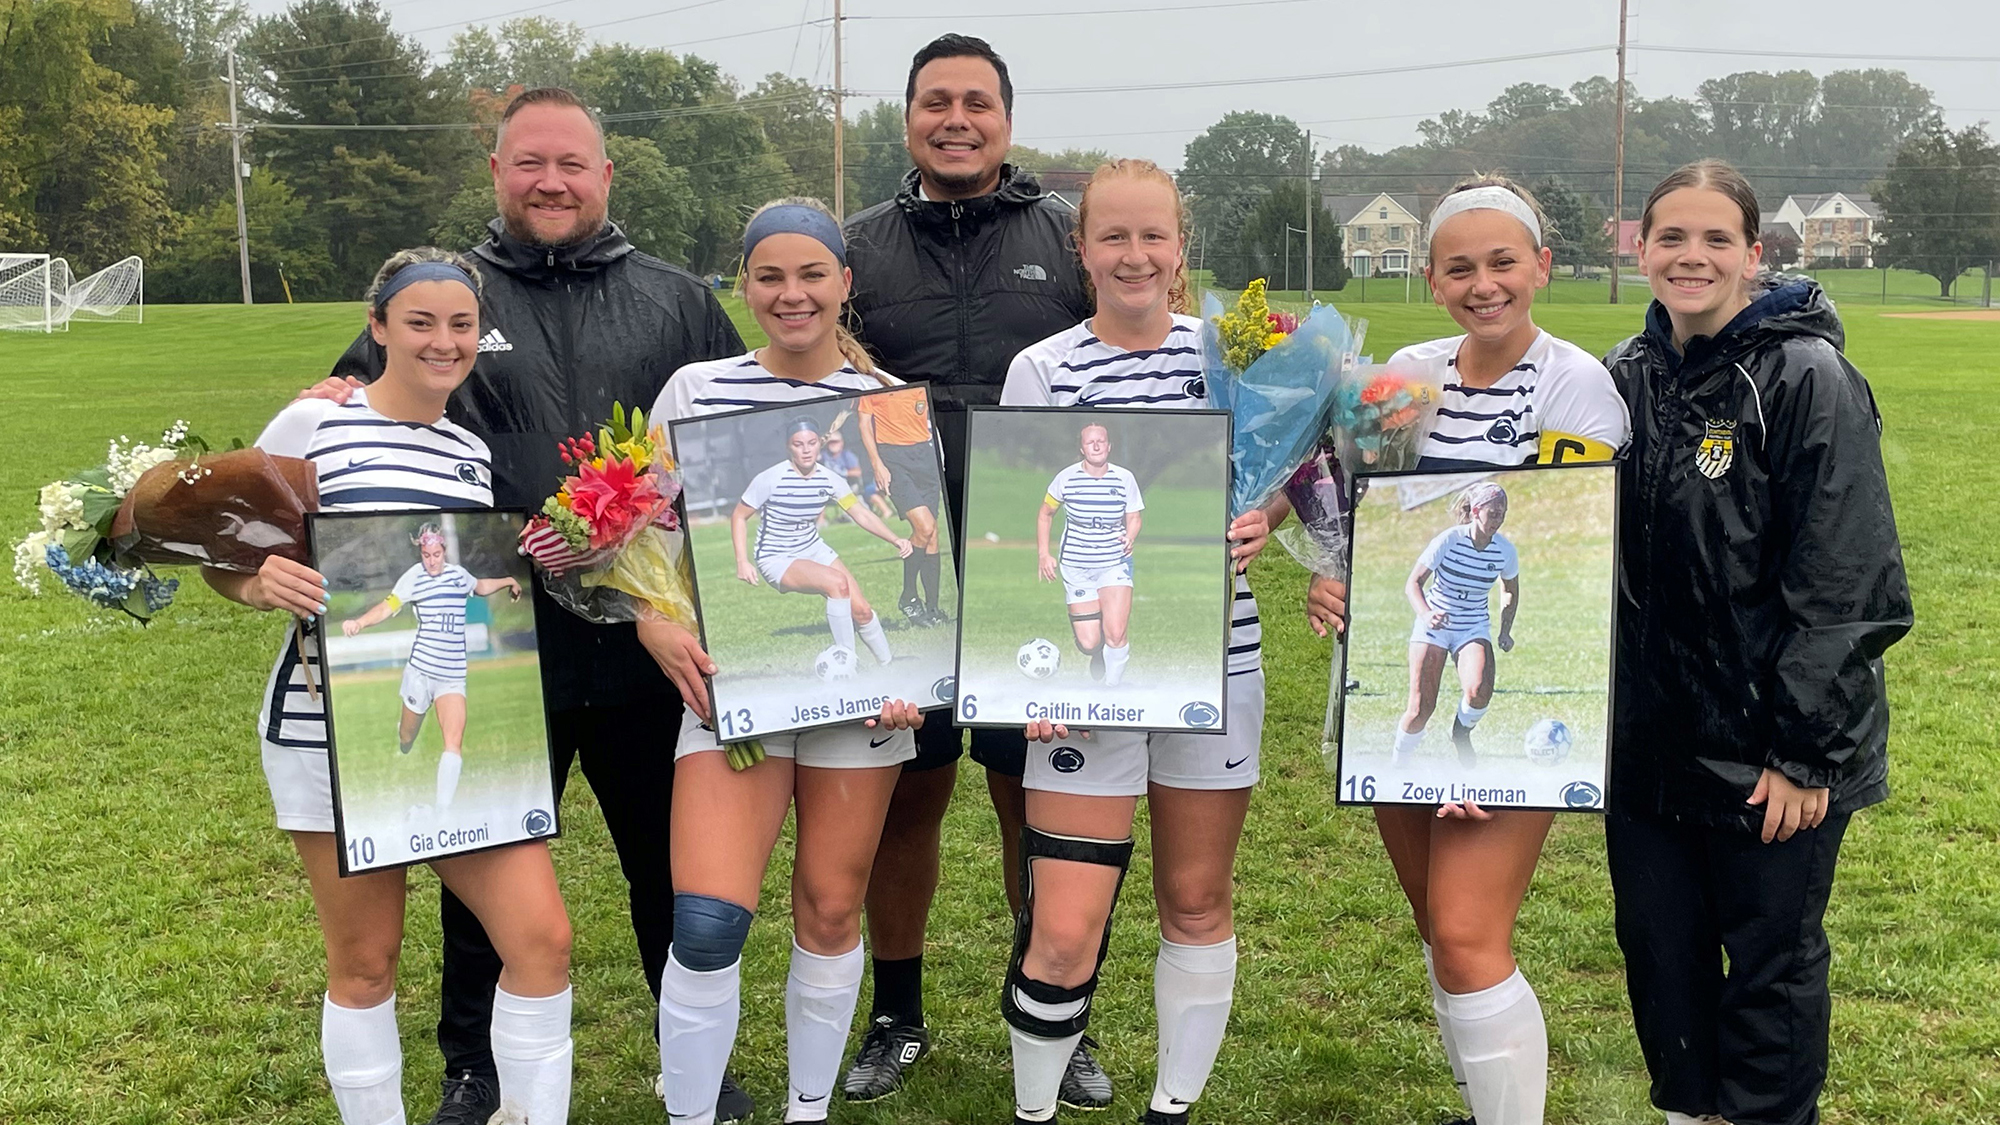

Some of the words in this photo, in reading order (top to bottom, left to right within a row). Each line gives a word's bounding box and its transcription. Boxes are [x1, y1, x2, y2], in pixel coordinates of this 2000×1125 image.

[1092, 516, 1102, 529] 6
[790, 705, 831, 724] Jess
[962, 694, 977, 719] 6
[1025, 701, 1082, 720] Caitlin
[1087, 703, 1145, 722] Kaiser
[721, 709, 754, 736] 13
[1345, 775, 1377, 802] 16
[1401, 782, 1445, 804] Zoey
[1450, 783, 1526, 803] Lineman
[409, 833, 434, 853] Gia
[437, 823, 490, 848] Cetroni
[348, 836, 376, 867] 10
